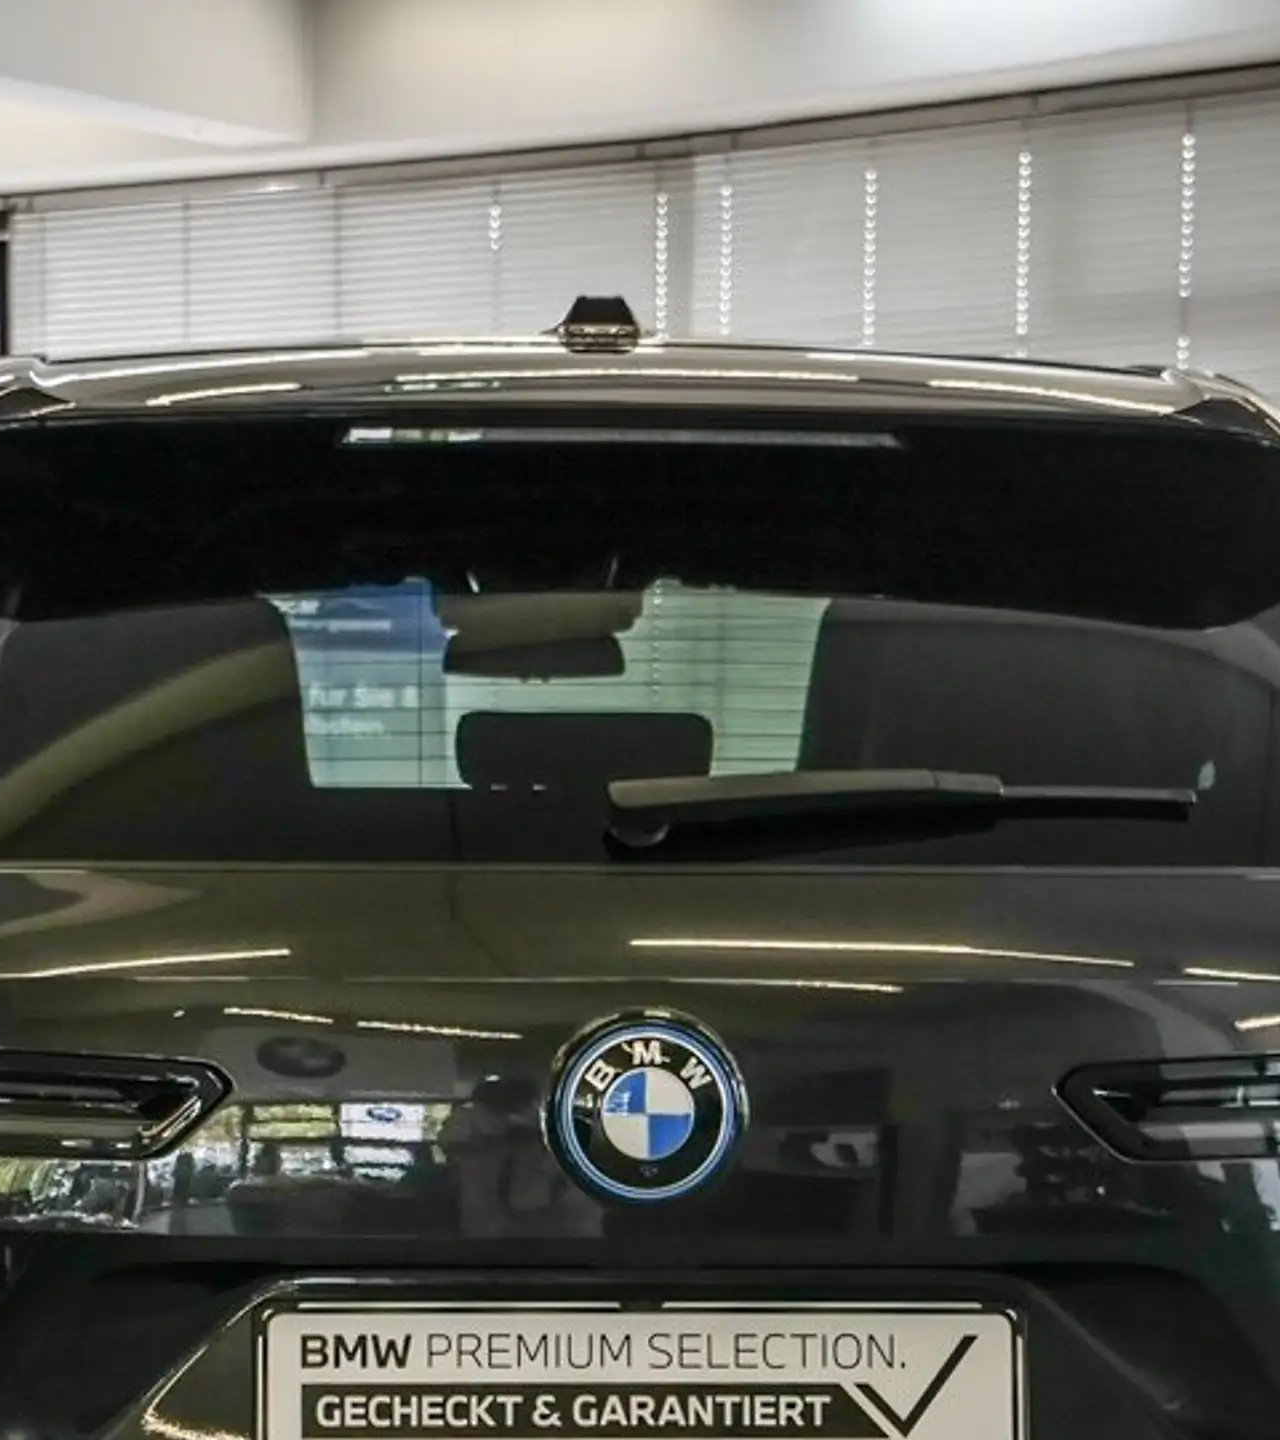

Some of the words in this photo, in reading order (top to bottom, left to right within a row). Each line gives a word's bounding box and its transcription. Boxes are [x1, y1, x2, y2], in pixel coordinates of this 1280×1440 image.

[584, 1039, 714, 1092] BMW
[300, 1333, 412, 1369] BMW
[426, 1333, 632, 1369] PREMIUM
[647, 1333, 907, 1369] SELECTION.
[316, 1394, 524, 1429] GECHECKT
[531, 1394, 564, 1429] &
[572, 1394, 831, 1428] GARANTIERT
